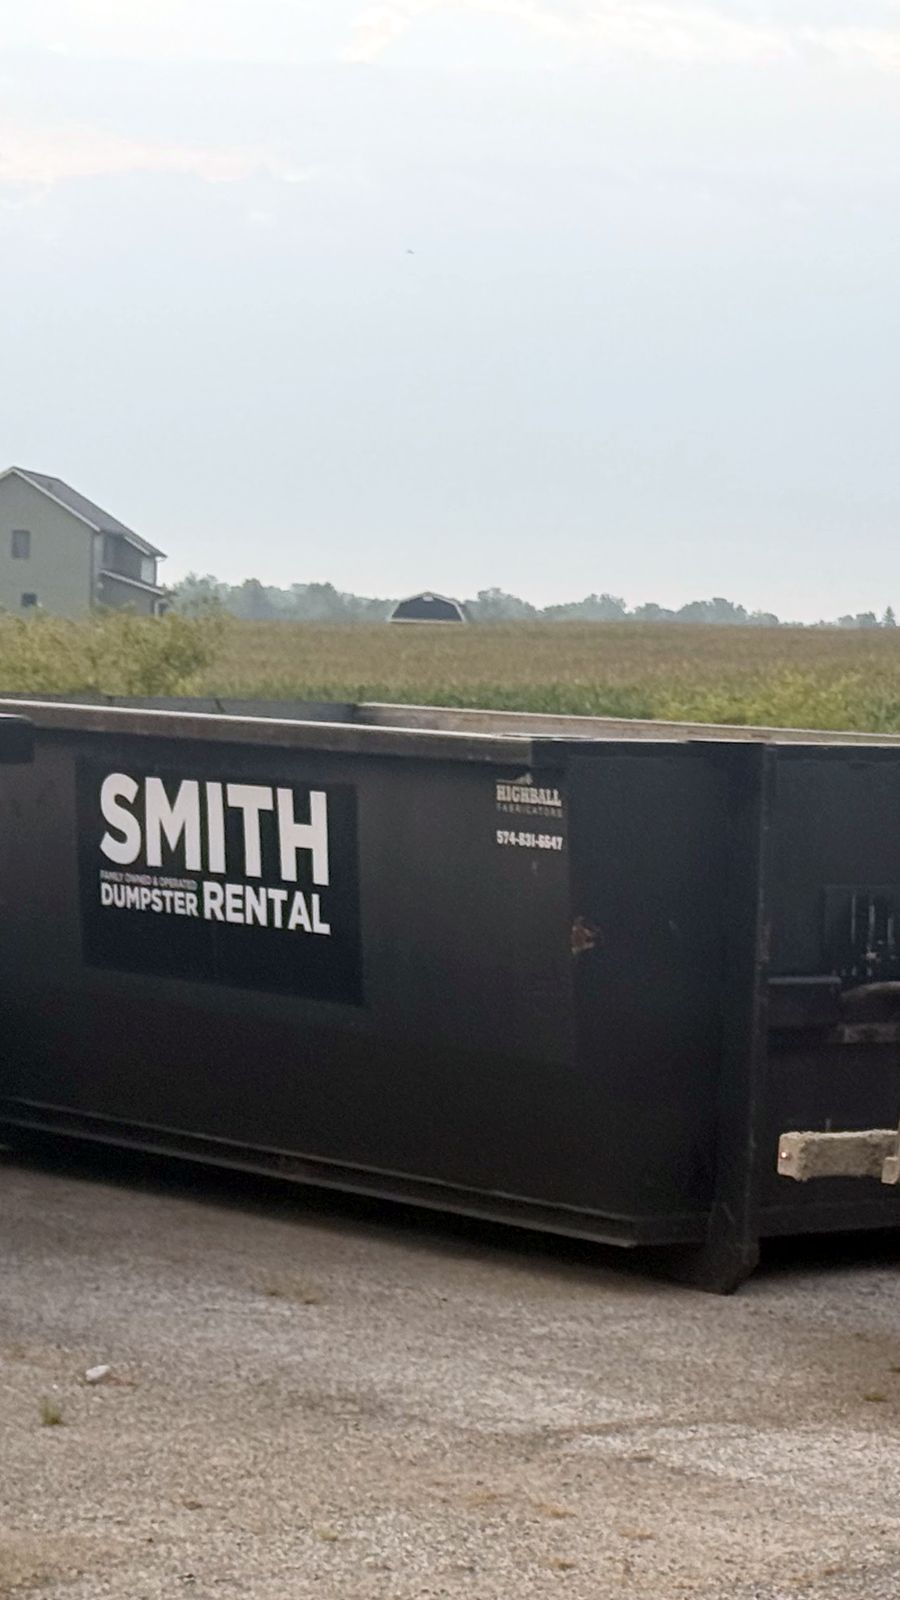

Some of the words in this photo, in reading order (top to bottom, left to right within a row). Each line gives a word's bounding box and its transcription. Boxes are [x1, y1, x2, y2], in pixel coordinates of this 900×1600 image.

[496, 785, 562, 807] HIGHBALL
[99, 772, 329, 886] SMITH
[101, 882, 199, 917] DUMPSTER
[202, 881, 331, 935] RENTAL
